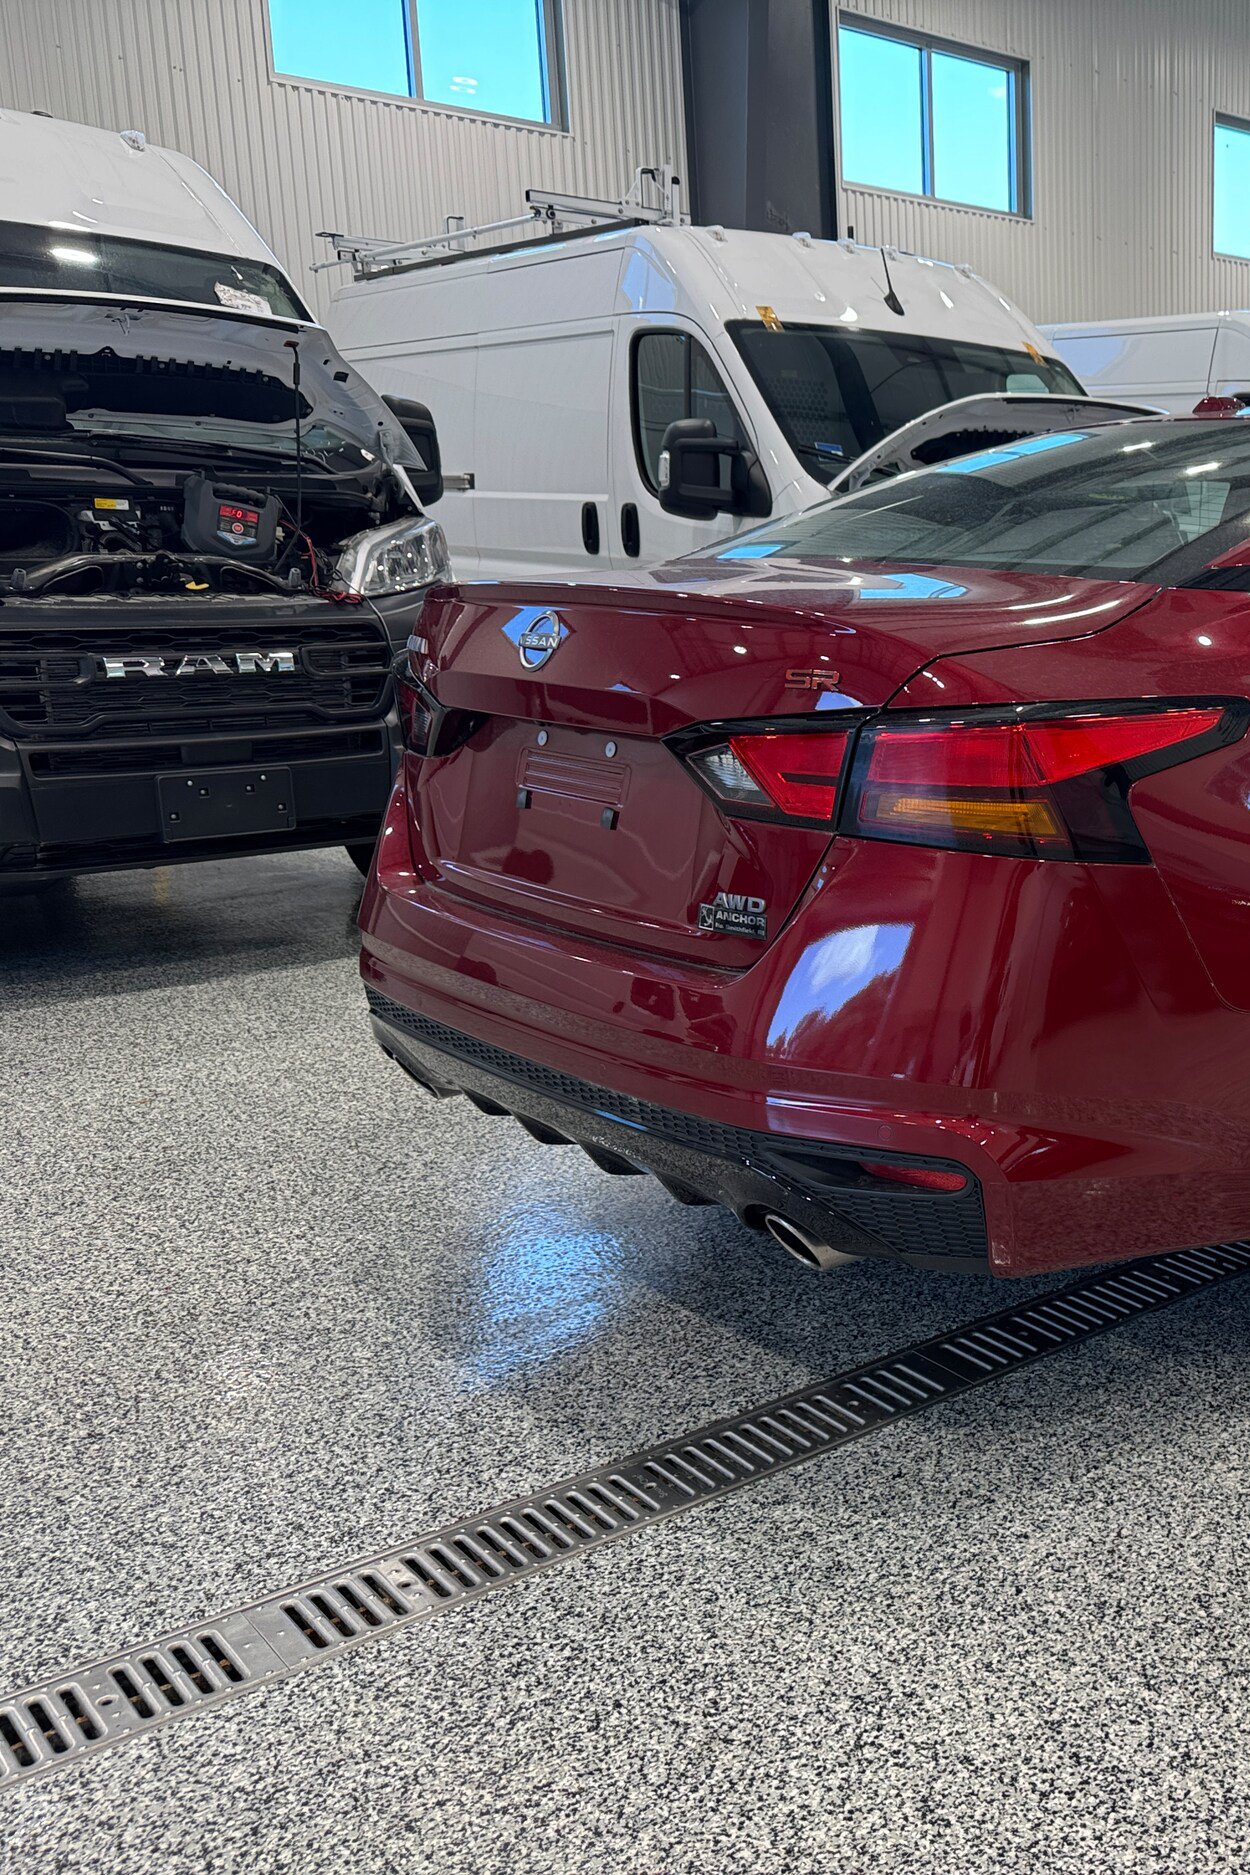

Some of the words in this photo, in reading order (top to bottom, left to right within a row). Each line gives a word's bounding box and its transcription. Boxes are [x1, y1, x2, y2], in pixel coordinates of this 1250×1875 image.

[520, 634, 559, 648] SSAN
[103, 652, 296, 679] RAM
[784, 668, 840, 691] SR
[712, 891, 766, 913] AWD
[715, 910, 765, 927] ANCHOR
